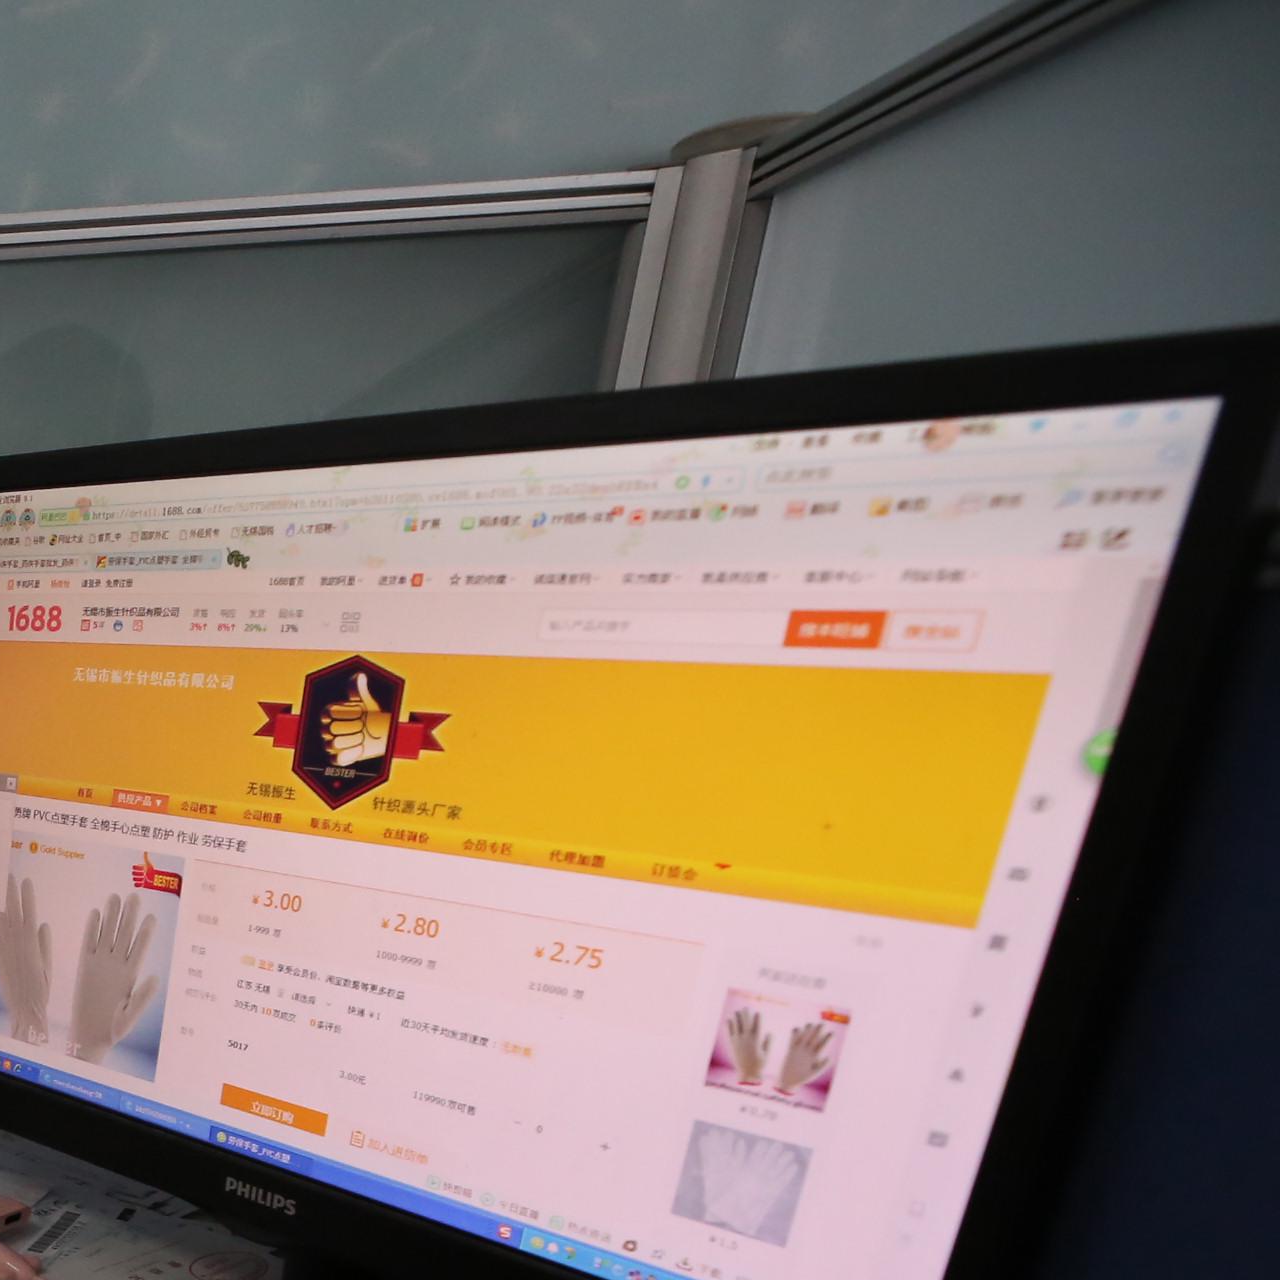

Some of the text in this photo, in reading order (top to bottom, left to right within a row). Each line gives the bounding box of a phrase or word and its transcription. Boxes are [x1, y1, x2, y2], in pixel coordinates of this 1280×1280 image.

[8, 605, 63, 632] 1688
[246, 782, 296, 800] 无锡振生
[372, 797, 463, 820] 针织源头厂家
[33, 808, 88, 828] PVC点塑手套
[153, 826, 175, 841] 防护
[177, 831, 199, 846] 作业
[202, 834, 248, 853] 劳保手套
[227, 1039, 249, 1052] 5017
[224, 1176, 297, 1216] PHILIPS
